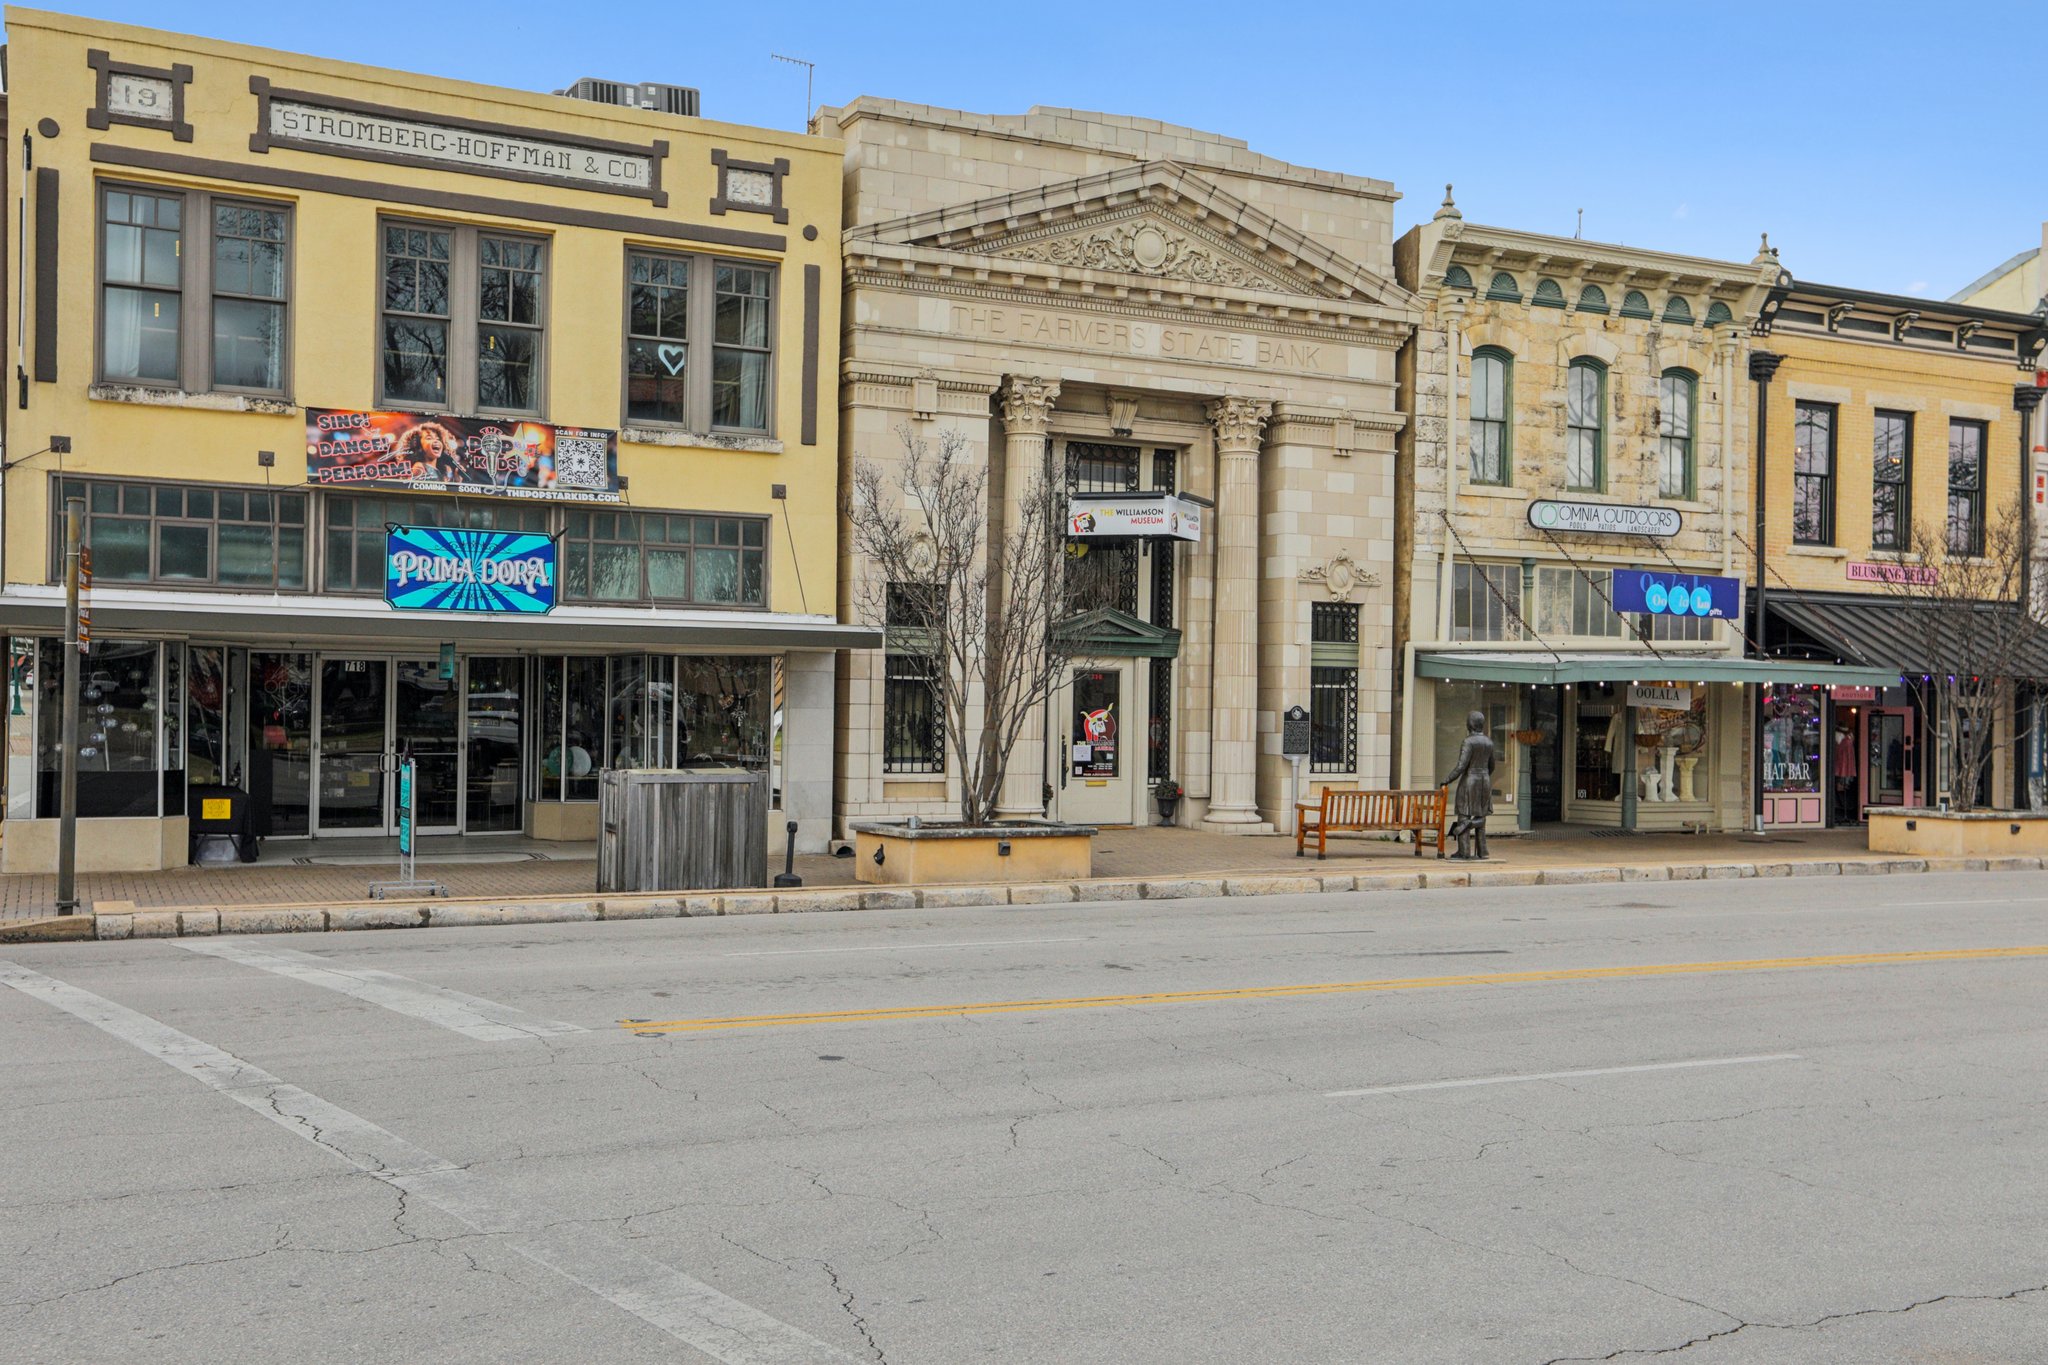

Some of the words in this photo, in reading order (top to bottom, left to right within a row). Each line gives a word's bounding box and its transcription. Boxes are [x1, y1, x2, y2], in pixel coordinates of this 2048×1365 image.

[124, 84, 157, 107] 19
[283, 111, 571, 170] STROMBERG-HOFFMAN
[584, 156, 599, 174] &
[951, 306, 1007, 333] THE
[1018, 313, 1146, 349] FARMERS
[1161, 330, 1244, 361] STATE
[1257, 340, 1321, 369] BANK
[318, 413, 371, 430] SING!
[480, 426, 503, 436] THE
[555, 429, 573, 437] SCAN
[319, 437, 389, 457] DANCE!
[468, 435, 513, 457] PP
[319, 461, 412, 482] PERFORM!
[474, 456, 519, 472] KDS
[412, 483, 447, 492] COMING
[458, 485, 482, 494] SOON
[506, 489, 620, 502] THEPOPSTARKIDS.COM
[1100, 508, 1114, 516] THE
[1116, 508, 1164, 516] WILLIAMSON
[1559, 505, 1600, 522] OMNIA
[1604, 508, 1672, 527] OUTDOORS
[1131, 517, 1164, 525] MUSEUM
[1569, 522, 1587, 530] POOLS
[1598, 523, 1616, 531] PATIOS
[1627, 525, 1661, 534] LANDSCAPES
[392, 550, 476, 587] PRIMA
[481, 556, 550, 594] DORA
[1709, 608, 1723, 616] gifts
[345, 661, 366, 672] 718
[1636, 687, 1680, 700] OOLALA
[1763, 762, 1787, 780] HAT
[1788, 762, 1811, 780] BAR
